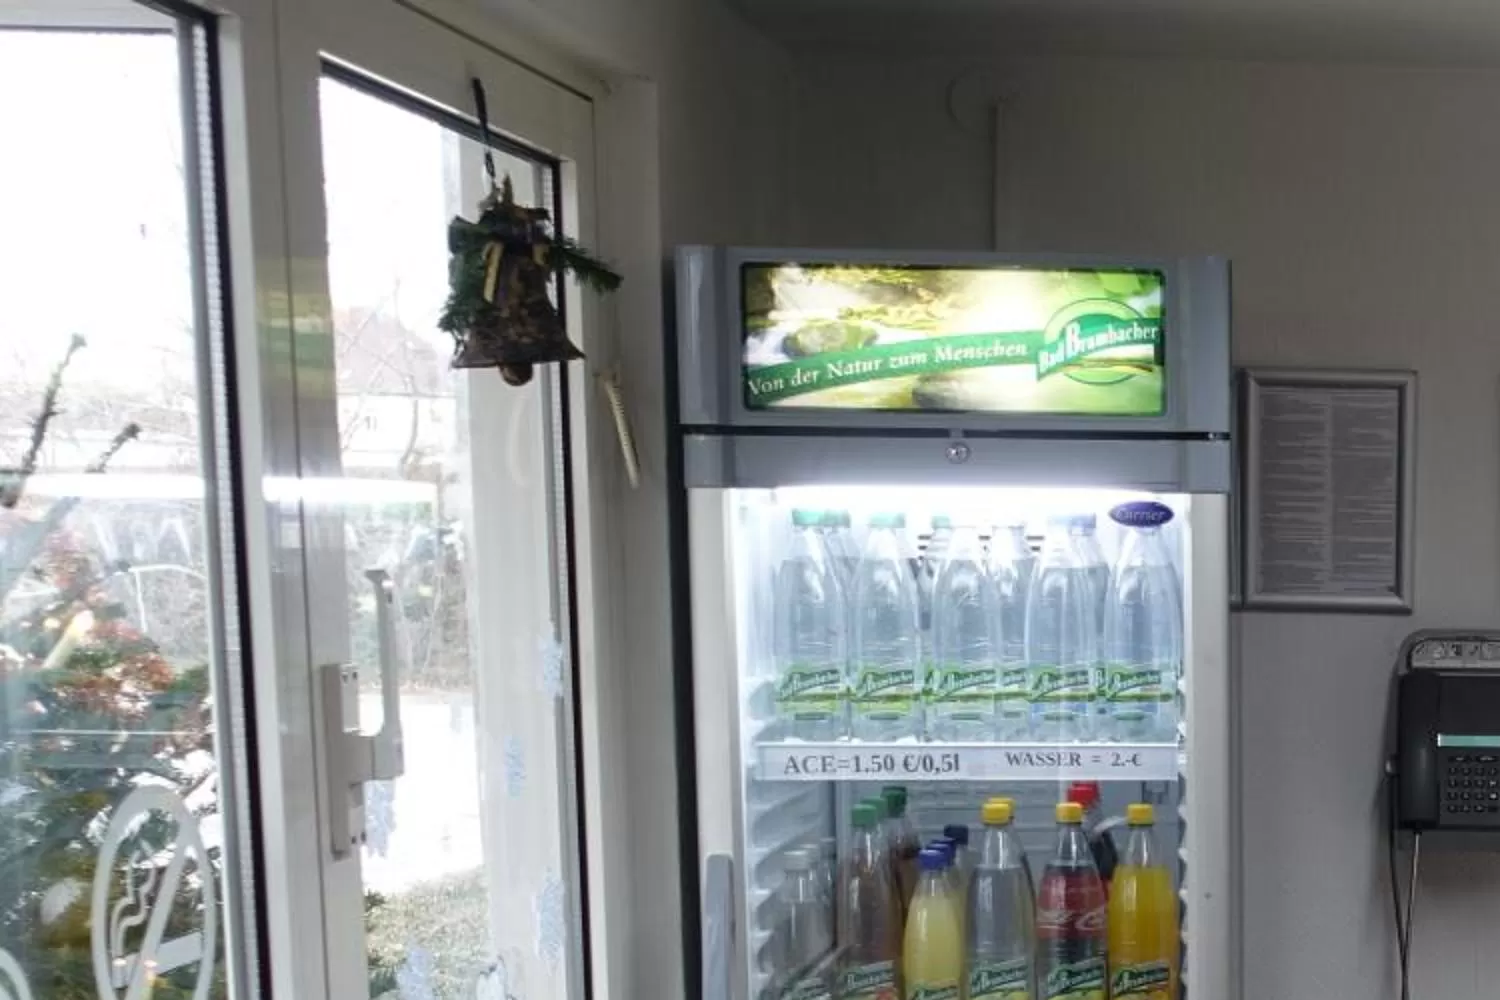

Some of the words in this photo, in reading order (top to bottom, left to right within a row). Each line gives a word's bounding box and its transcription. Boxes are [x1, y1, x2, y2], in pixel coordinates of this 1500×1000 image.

[748, 377, 786, 396] Von
[791, 367, 820, 387] der
[826, 358, 884, 379] Natur
[889, 352, 928, 369] zum
[934, 340, 1028, 363] Menschen
[1038, 337, 1065, 375] Bad
[1064, 319, 1161, 359] Brambacher
[1005, 752, 1081, 767] WASSER
